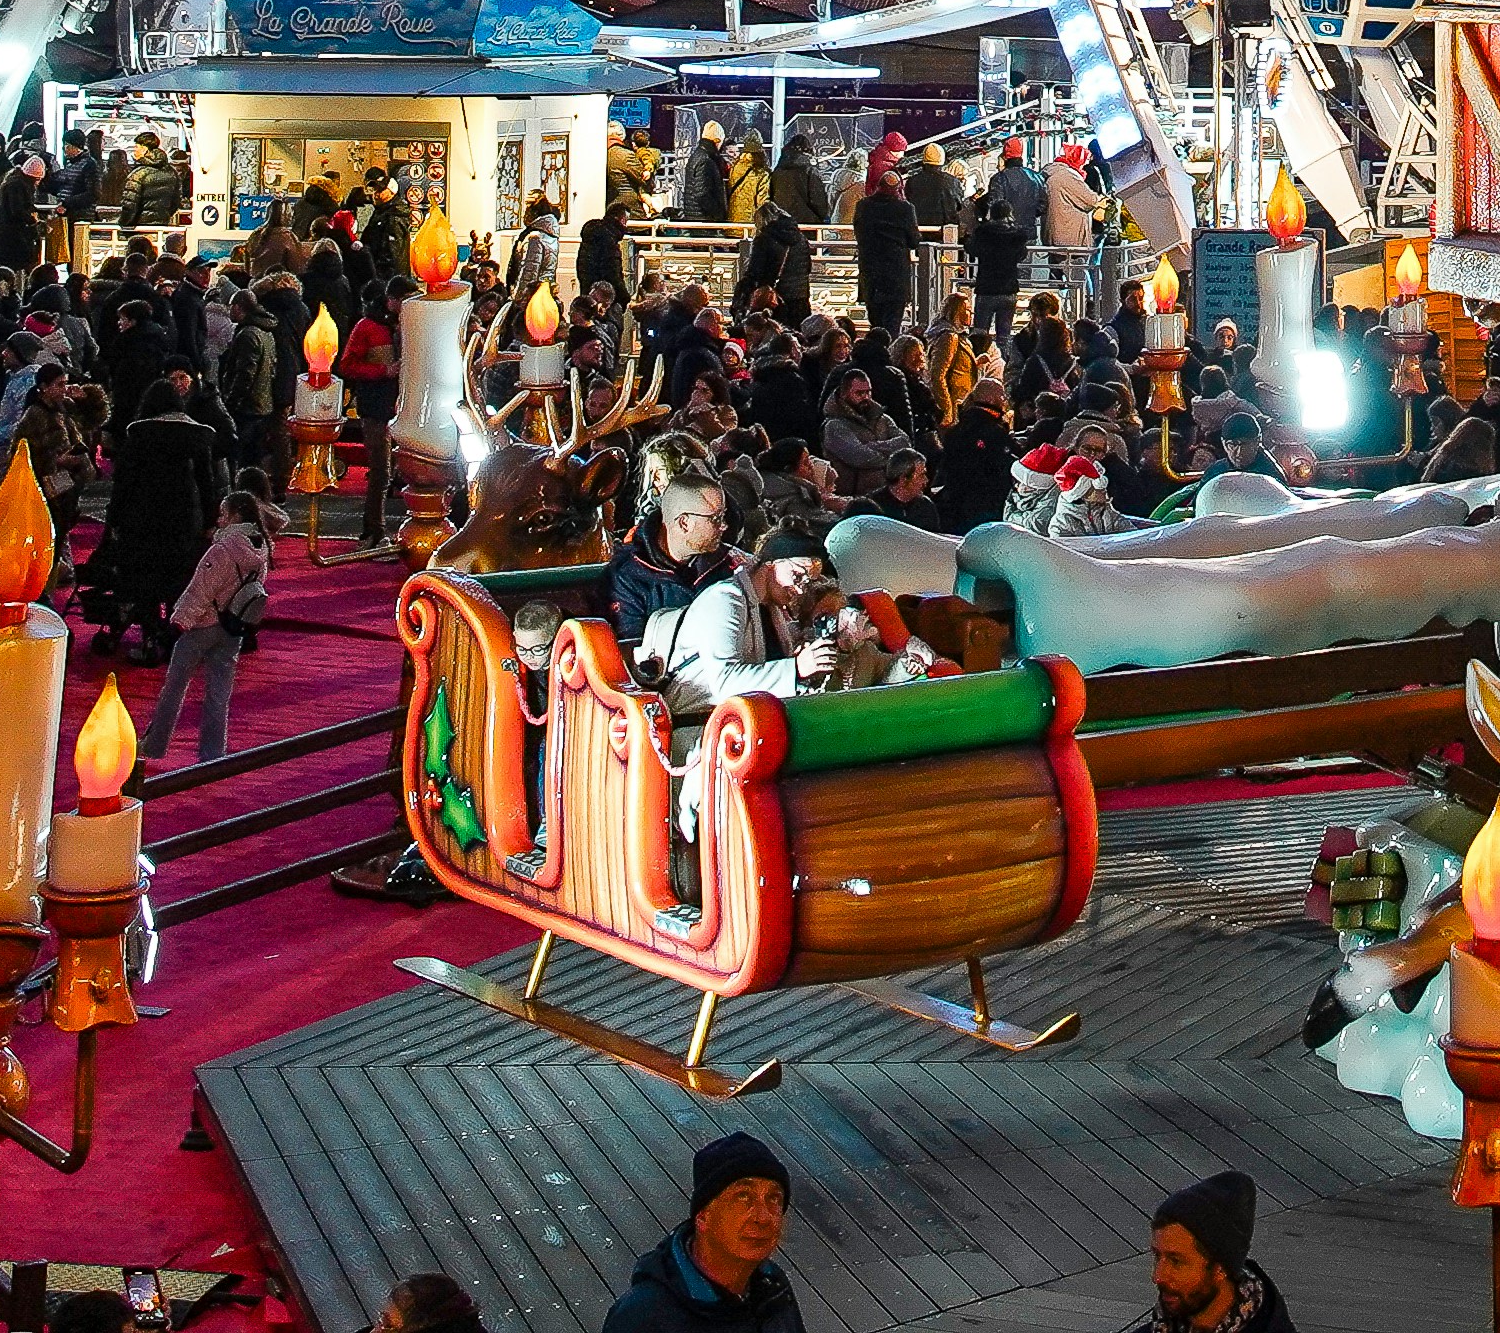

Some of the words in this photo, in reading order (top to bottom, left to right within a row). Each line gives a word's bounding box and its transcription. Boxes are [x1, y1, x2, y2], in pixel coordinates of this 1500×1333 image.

[290, 4, 374, 43] Grande
[381, 1, 457, 47] Roue
[1205, 239, 1245, 253] Grande
